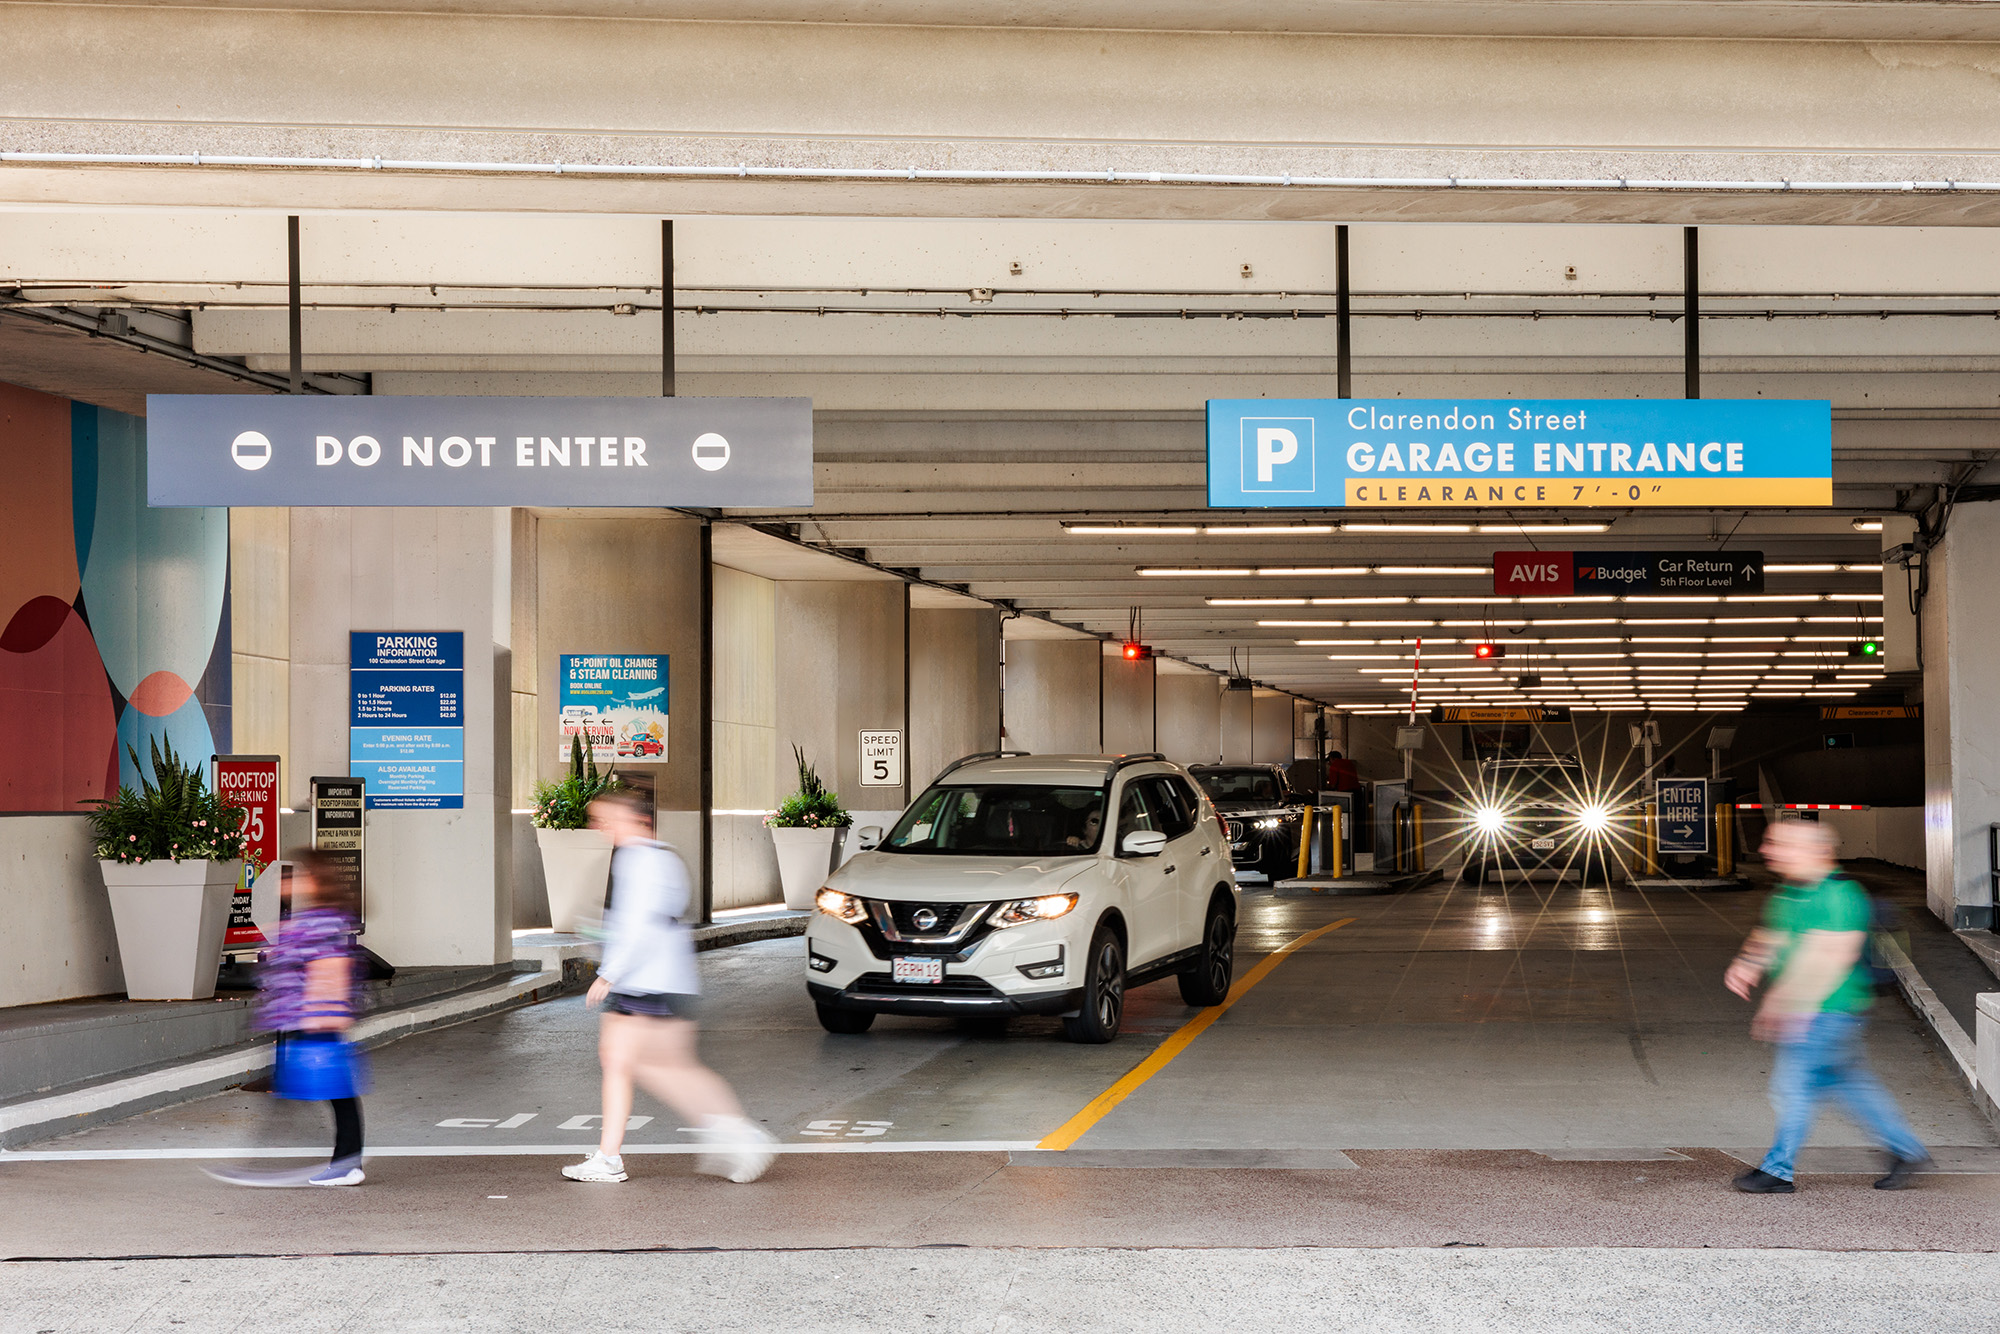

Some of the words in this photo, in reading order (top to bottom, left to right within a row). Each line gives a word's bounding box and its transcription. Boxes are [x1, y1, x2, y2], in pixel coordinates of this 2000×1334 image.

[1347, 406, 1495, 430] Clarendon
[1508, 406, 1587, 430] Street
[315, 435, 381, 467] DO
[402, 436, 497, 467] NOT
[515, 436, 649, 467] ENTER
[1257, 427, 1298, 482] P
[1346, 442, 1515, 473] GARAGE
[1533, 442, 1744, 473] ENTRANCE
[1356, 486, 1545, 501] CLEARANCE
[1509, 564, 1560, 582] AVIS
[1658, 559, 1684, 573] Car
[1687, 559, 1733, 573] Return
[1597, 566, 1647, 583] Budget
[1660, 576, 1677, 586] 5th
[1678, 576, 1698, 586] Floor
[1700, 576, 1732, 586] Level
[376, 636, 438, 648] PARKING
[570, 658, 608, 668] 15-POINT
[610, 658, 623, 668] OIL
[624, 658, 658, 668] CHANGE
[570, 669, 576, 680] &
[578, 669, 610, 680] STEAM
[612, 669, 658, 680] CLEANING
[564, 726, 581, 735] NOW
[583, 726, 614, 735] SERVING
[864, 736, 898, 744] SPEED
[867, 748, 894, 756] LIMIT
[874, 760, 889, 780] 5
[220, 772, 275, 788] ROOFTOP
[228, 790, 268, 802] PARKING
[1663, 788, 1701, 803] ENTER
[1667, 807, 1698, 822] HERE
[246, 865, 254, 888] P
[927, 964, 940, 977] 12
